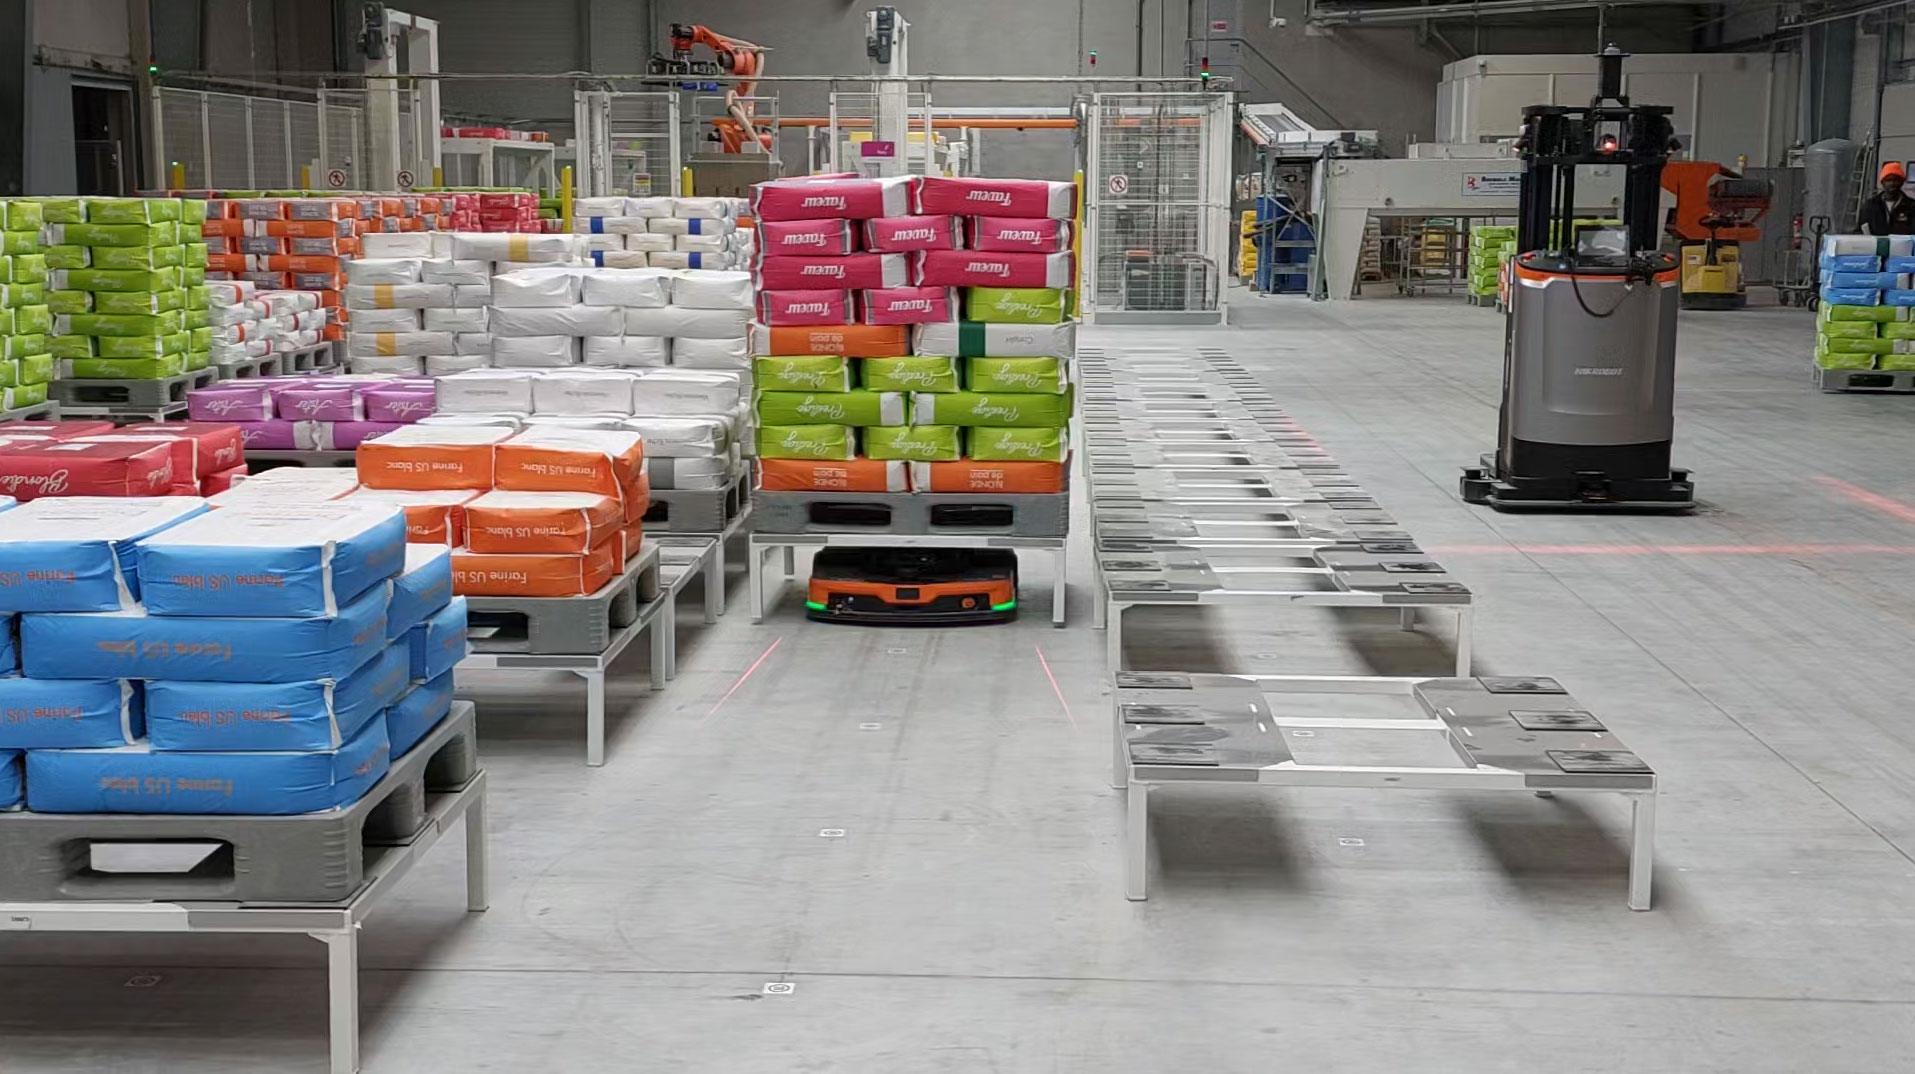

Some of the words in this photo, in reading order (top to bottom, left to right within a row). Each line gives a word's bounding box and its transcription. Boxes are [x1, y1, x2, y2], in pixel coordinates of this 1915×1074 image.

[801, 195, 847, 210] Faveur
[966, 190, 1012, 206] Faveur
[782, 232, 827, 247] Faveur
[892, 228, 936, 242] Faveur
[996, 230, 1042, 244] Faveur
[801, 264, 845, 279] Faveur
[965, 262, 1010, 277] Faveur
[786, 302, 830, 316] Faveur
[888, 299, 932, 312] Faveur
[206, 399, 242, 416] Aster
[295, 399, 332, 416] Aster
[386, 401, 422, 417] Aster
[386, 461, 412, 472] blanc
[415, 462, 429, 472] US
[432, 462, 463, 472] Farine
[520, 463, 546, 476] blanc
[549, 465, 563, 476] US
[565, 466, 596, 477] Farine
[0, 469, 68, 493] Blondie
[970, 471, 990, 479] pain
[485, 526, 513, 537] blanc
[515, 527, 530, 537] US
[26, 570, 75, 584] Farine
[209, 576, 231, 590] US
[469, 571, 486, 583] US
[490, 571, 527, 584] Farine
[6, 708, 28, 723] US
[215, 711, 237, 726] US
[145, 778, 171, 795] US
